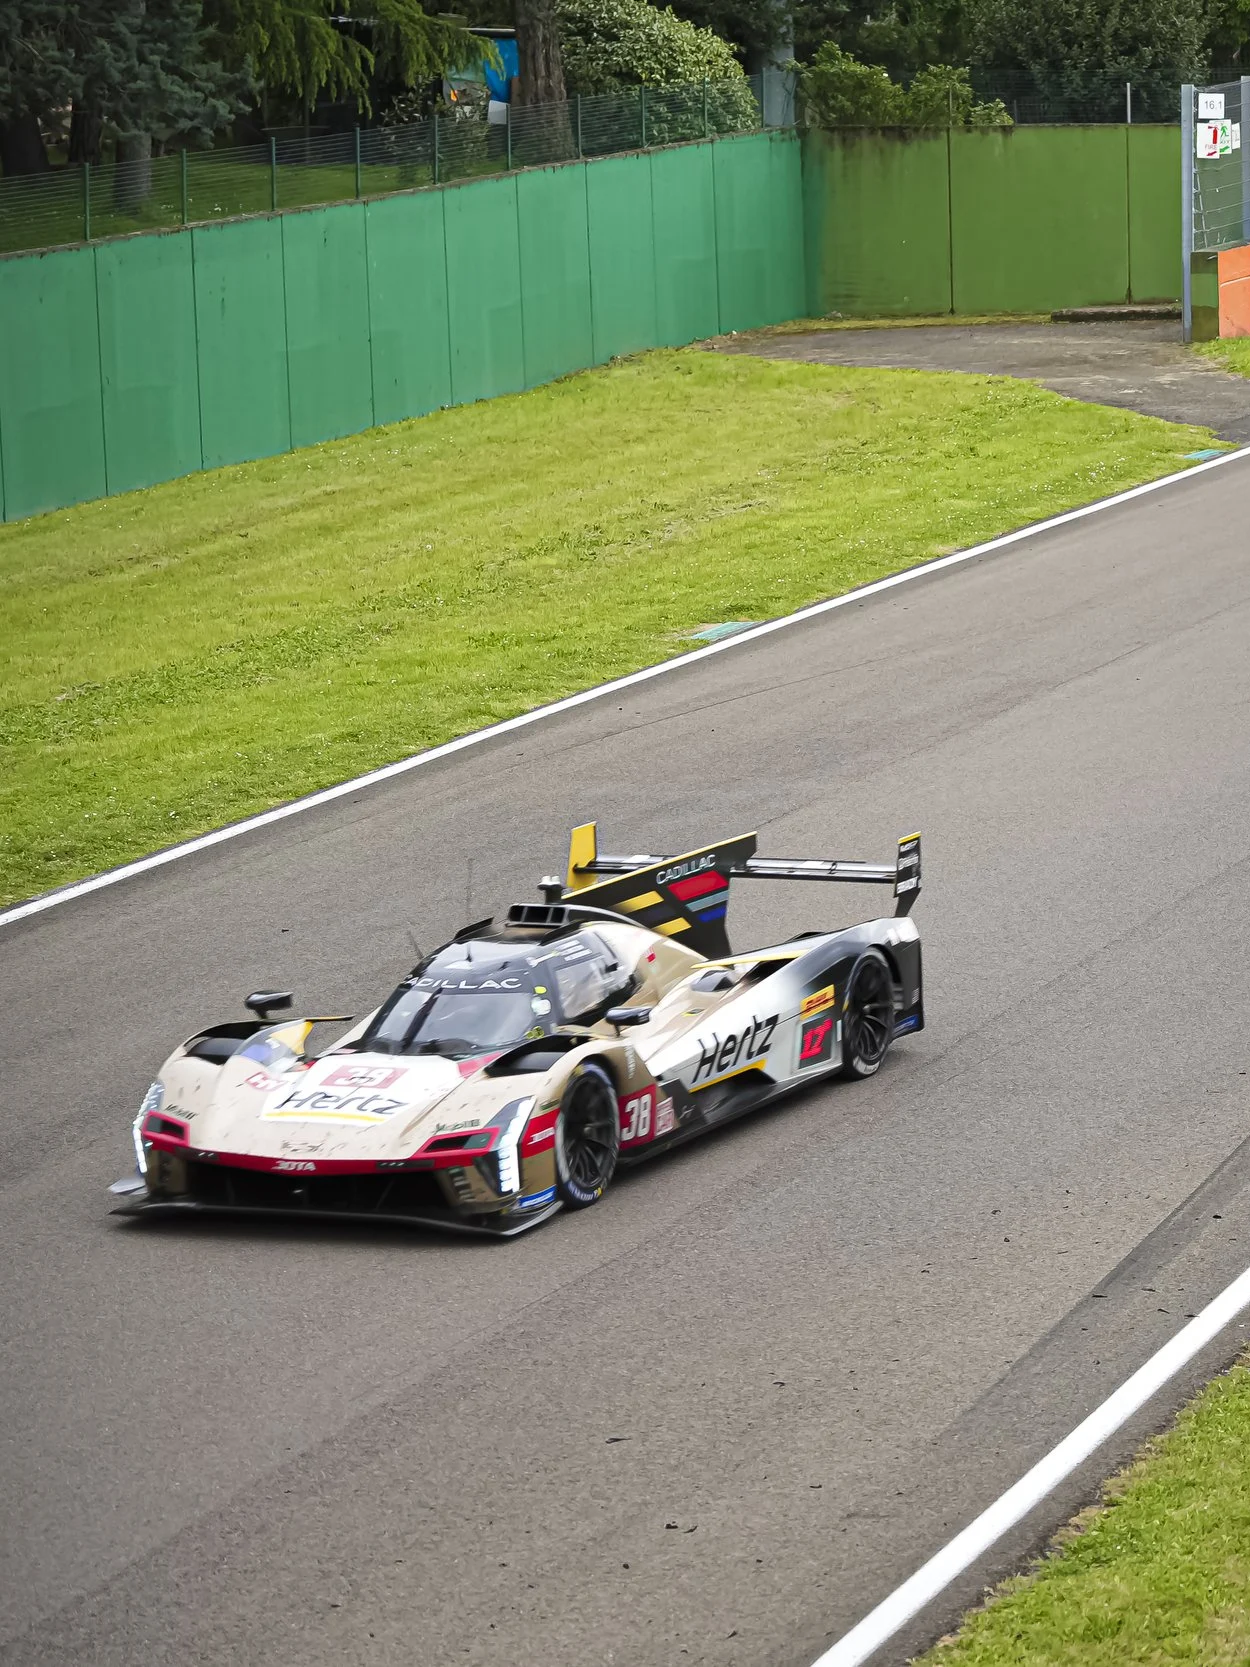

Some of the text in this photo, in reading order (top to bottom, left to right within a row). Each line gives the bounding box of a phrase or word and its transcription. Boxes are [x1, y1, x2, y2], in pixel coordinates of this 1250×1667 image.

[656, 854, 716, 885] CADILLAC
[691, 1014, 779, 1084] Hertz
[274, 1091, 409, 1115] Hertz
[621, 1094, 652, 1141] 38
